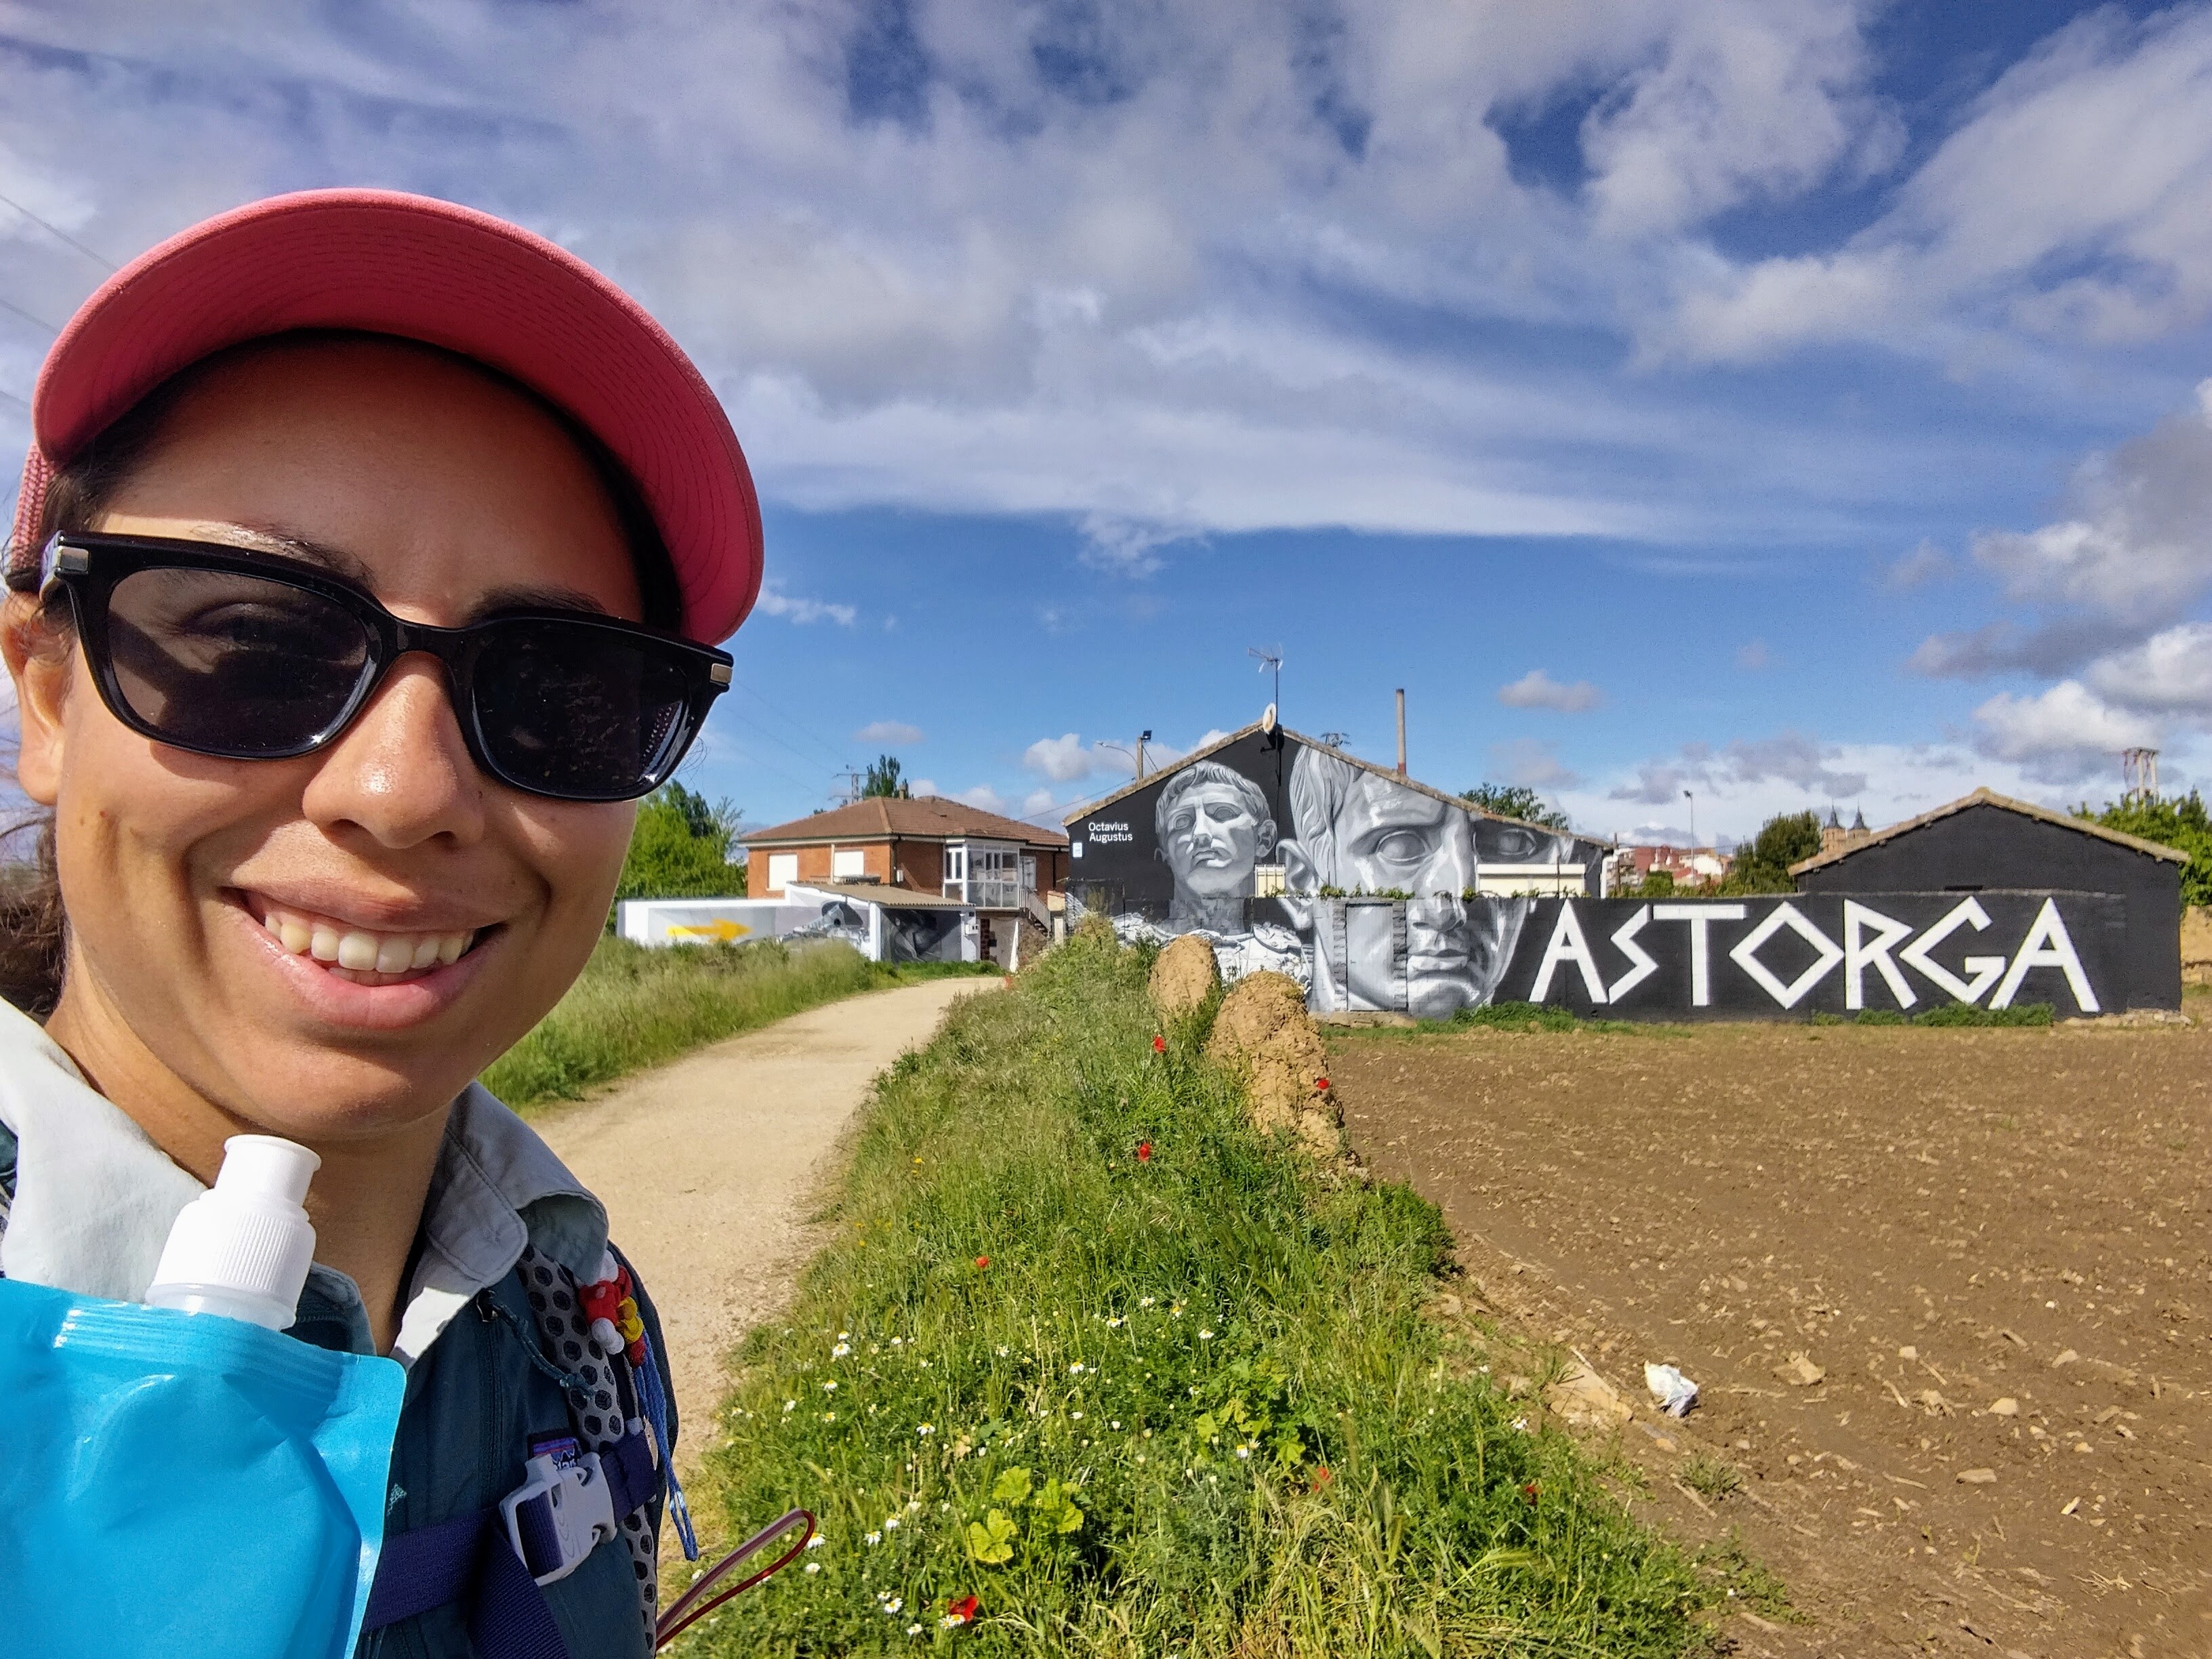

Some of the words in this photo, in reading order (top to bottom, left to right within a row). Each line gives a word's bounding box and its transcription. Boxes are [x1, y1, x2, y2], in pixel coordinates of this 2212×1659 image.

[1088, 821, 1128, 832] Octavius
[1089, 833, 1132, 843] Augustus
[1528, 896, 2100, 1012] ASTORGA
